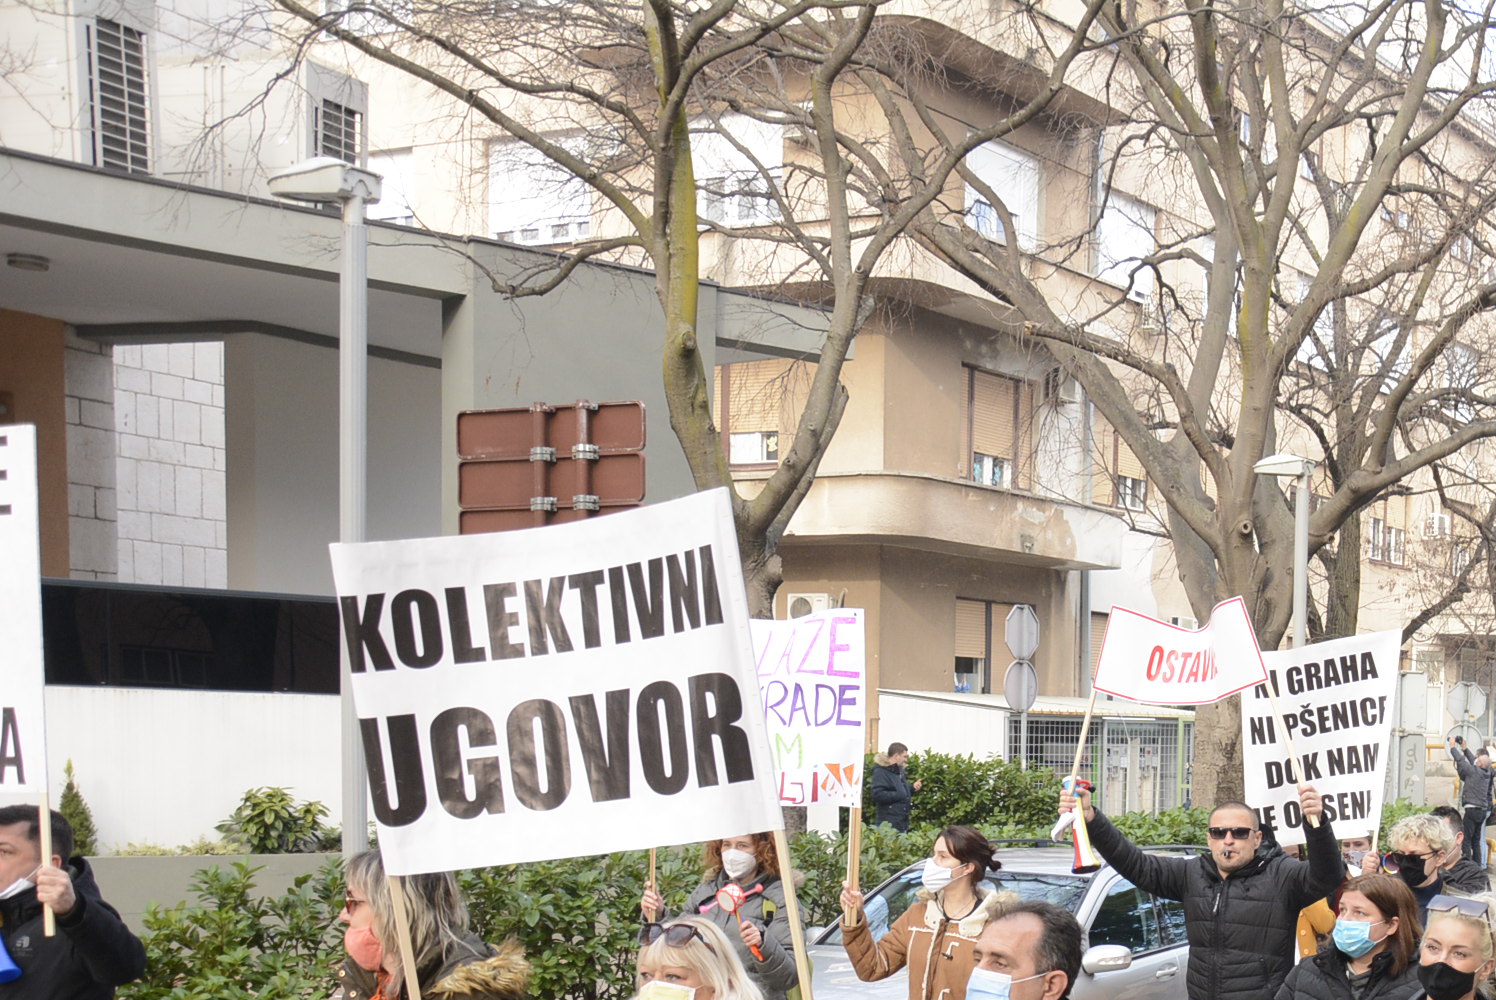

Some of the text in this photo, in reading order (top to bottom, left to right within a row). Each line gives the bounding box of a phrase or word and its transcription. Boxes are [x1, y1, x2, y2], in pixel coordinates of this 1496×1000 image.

[340, 544, 724, 673] KOLEKTIVNI
[1286, 651, 1379, 696] GRAHA
[760, 680, 861, 727] RADE
[359, 672, 755, 827] UGOVOR
[773, 732, 803, 770] M
[1249, 716, 1277, 745] NI
[1264, 752, 1322, 790] DOK
[1326, 742, 1380, 777] NAM
